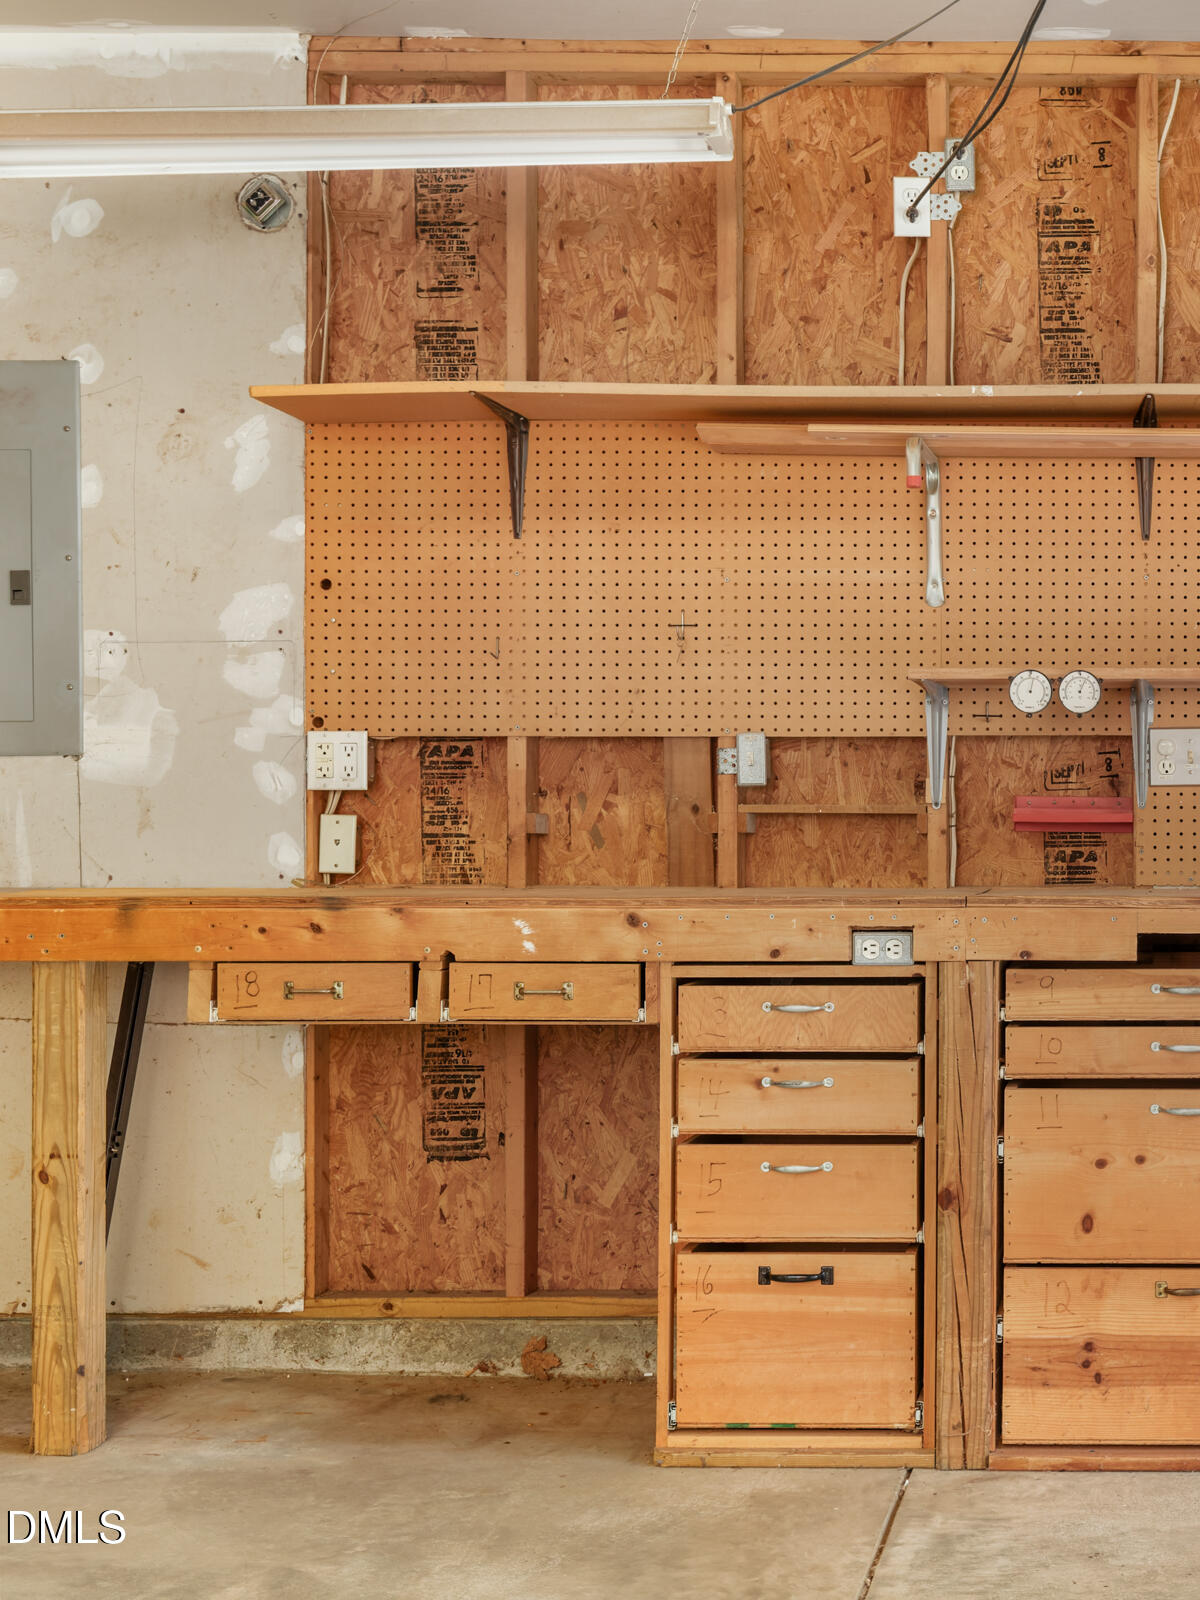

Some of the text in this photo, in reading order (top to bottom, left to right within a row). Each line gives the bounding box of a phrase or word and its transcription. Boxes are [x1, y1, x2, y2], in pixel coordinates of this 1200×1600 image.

[427, 745, 474, 758] APA
[1054, 850, 1098, 863] APA
[236, 970, 260, 1003] 18
[469, 973, 493, 1002] 17
[1040, 975, 1055, 999] 9
[1039, 1033, 1063, 1060] 10
[695, 1265, 714, 1301] 16
[1043, 1279, 1077, 1318] 12
